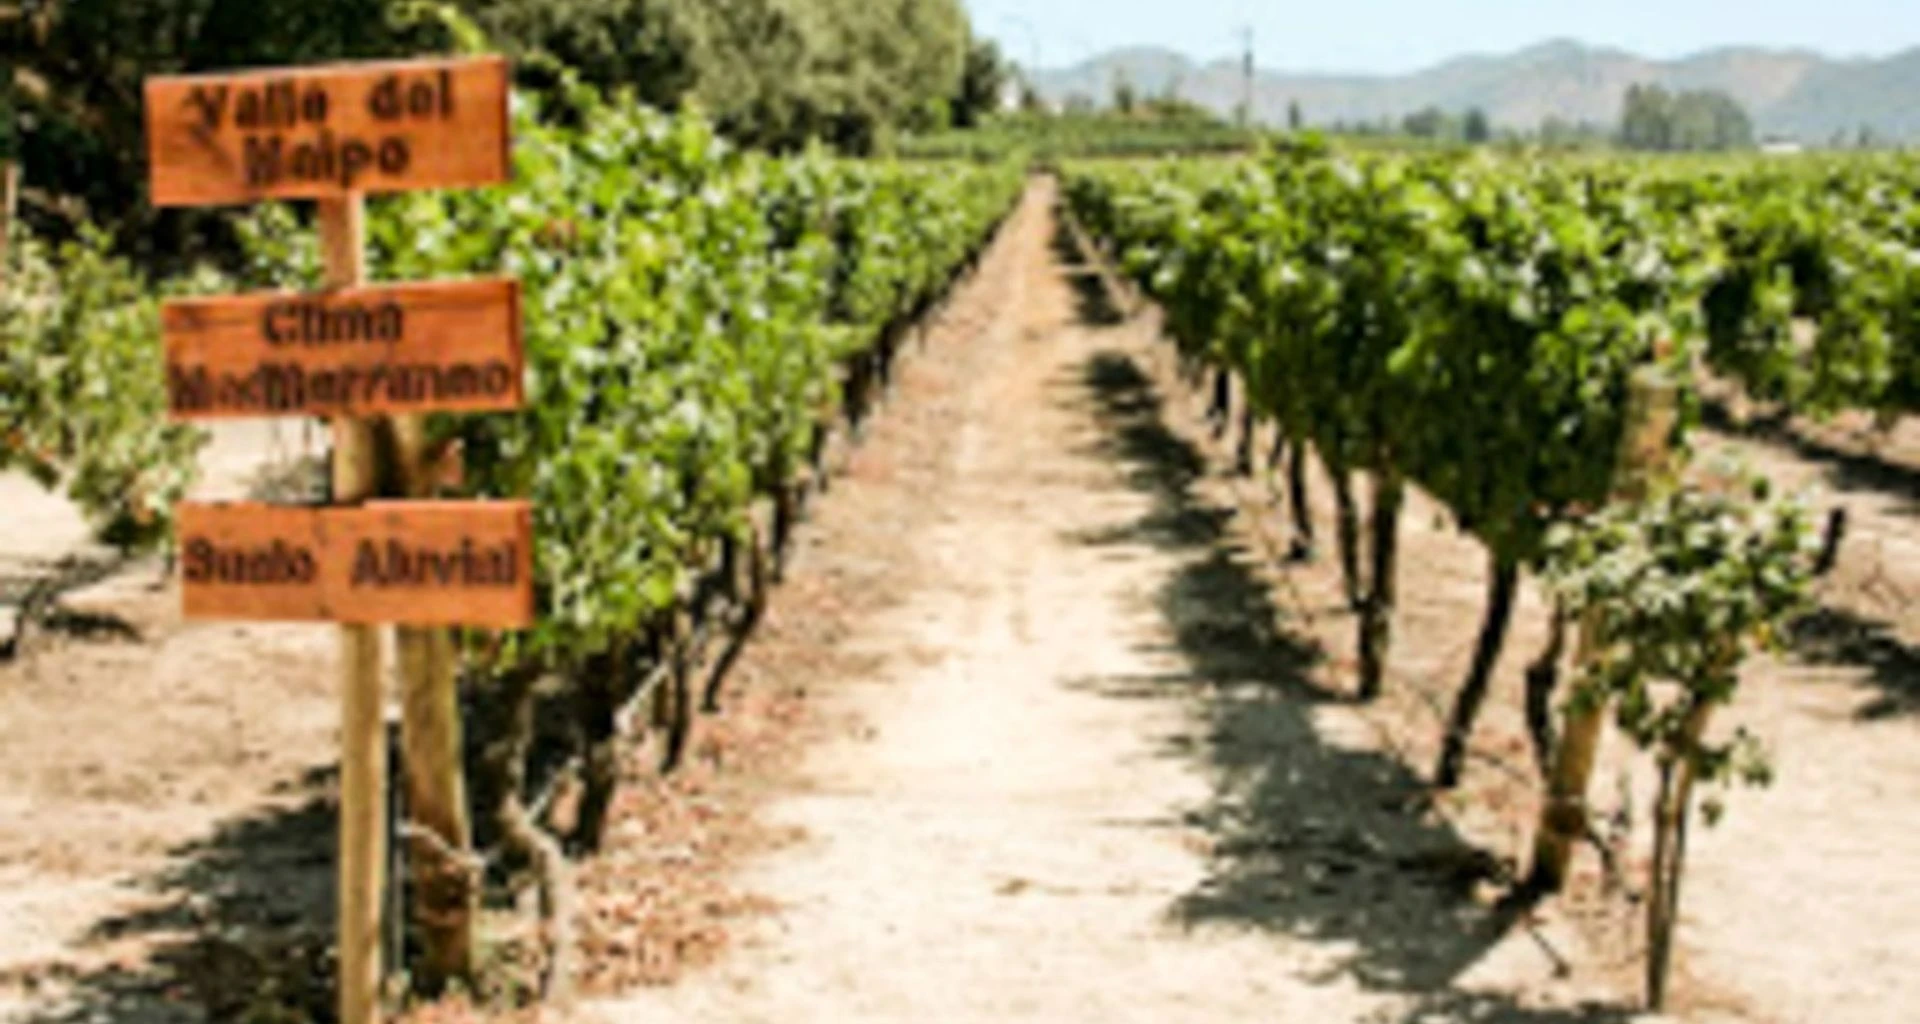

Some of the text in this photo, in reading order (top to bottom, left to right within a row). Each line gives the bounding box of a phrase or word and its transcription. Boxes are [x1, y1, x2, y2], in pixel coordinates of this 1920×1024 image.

[186, 69, 452, 130] Valle del
[243, 128, 411, 187] Maipo
[261, 299, 404, 346] Clima
[184, 535, 516, 586] Suelo Aluvial
